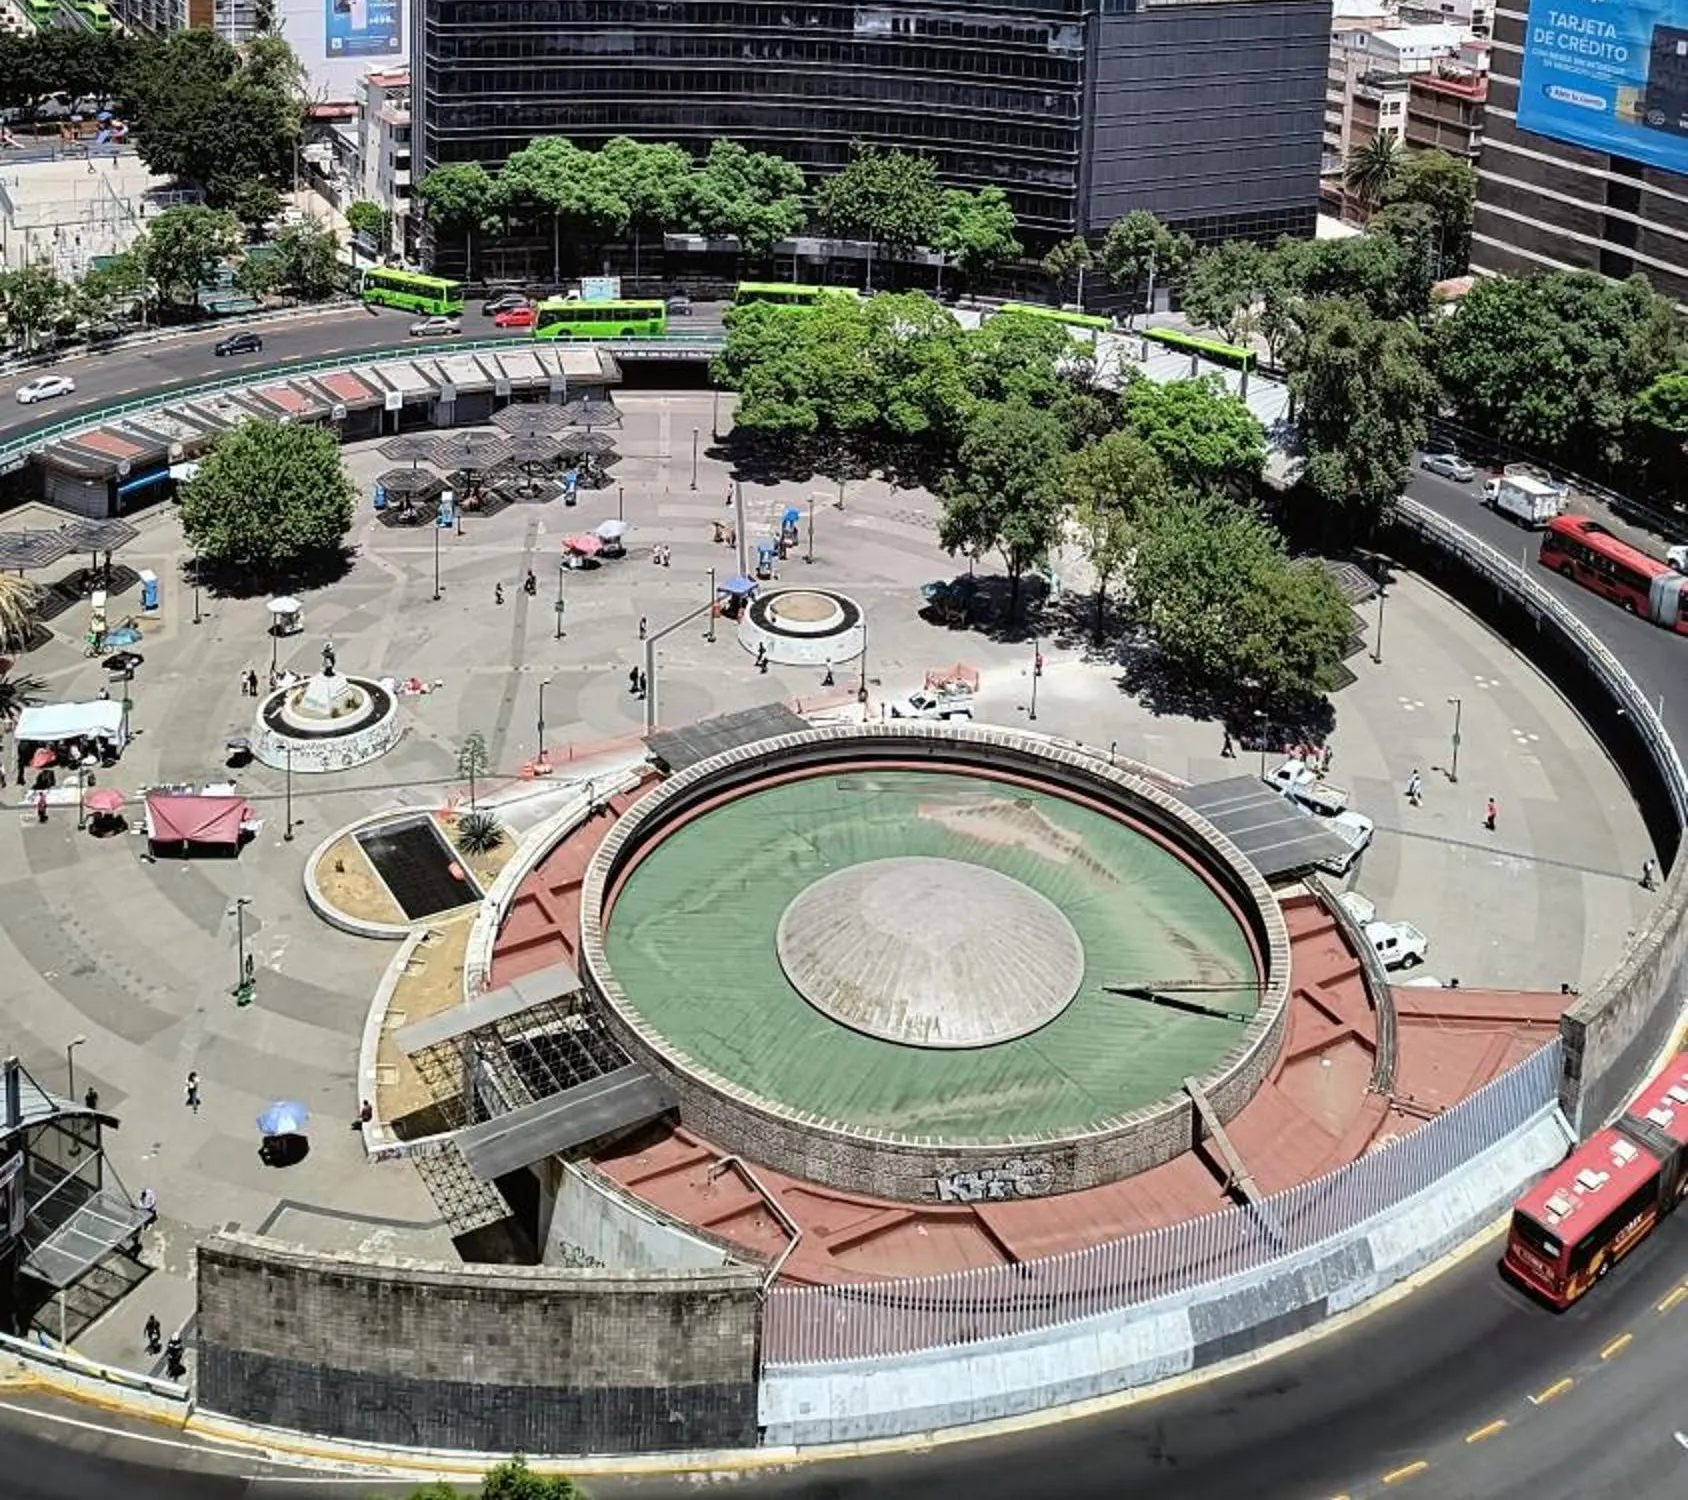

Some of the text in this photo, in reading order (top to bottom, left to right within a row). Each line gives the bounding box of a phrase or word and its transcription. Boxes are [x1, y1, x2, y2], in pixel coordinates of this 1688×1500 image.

[1548, 10, 1617, 39] TARJETA
[1533, 28, 1555, 45] DE
[1557, 33, 1628, 62] CRÉDITO
